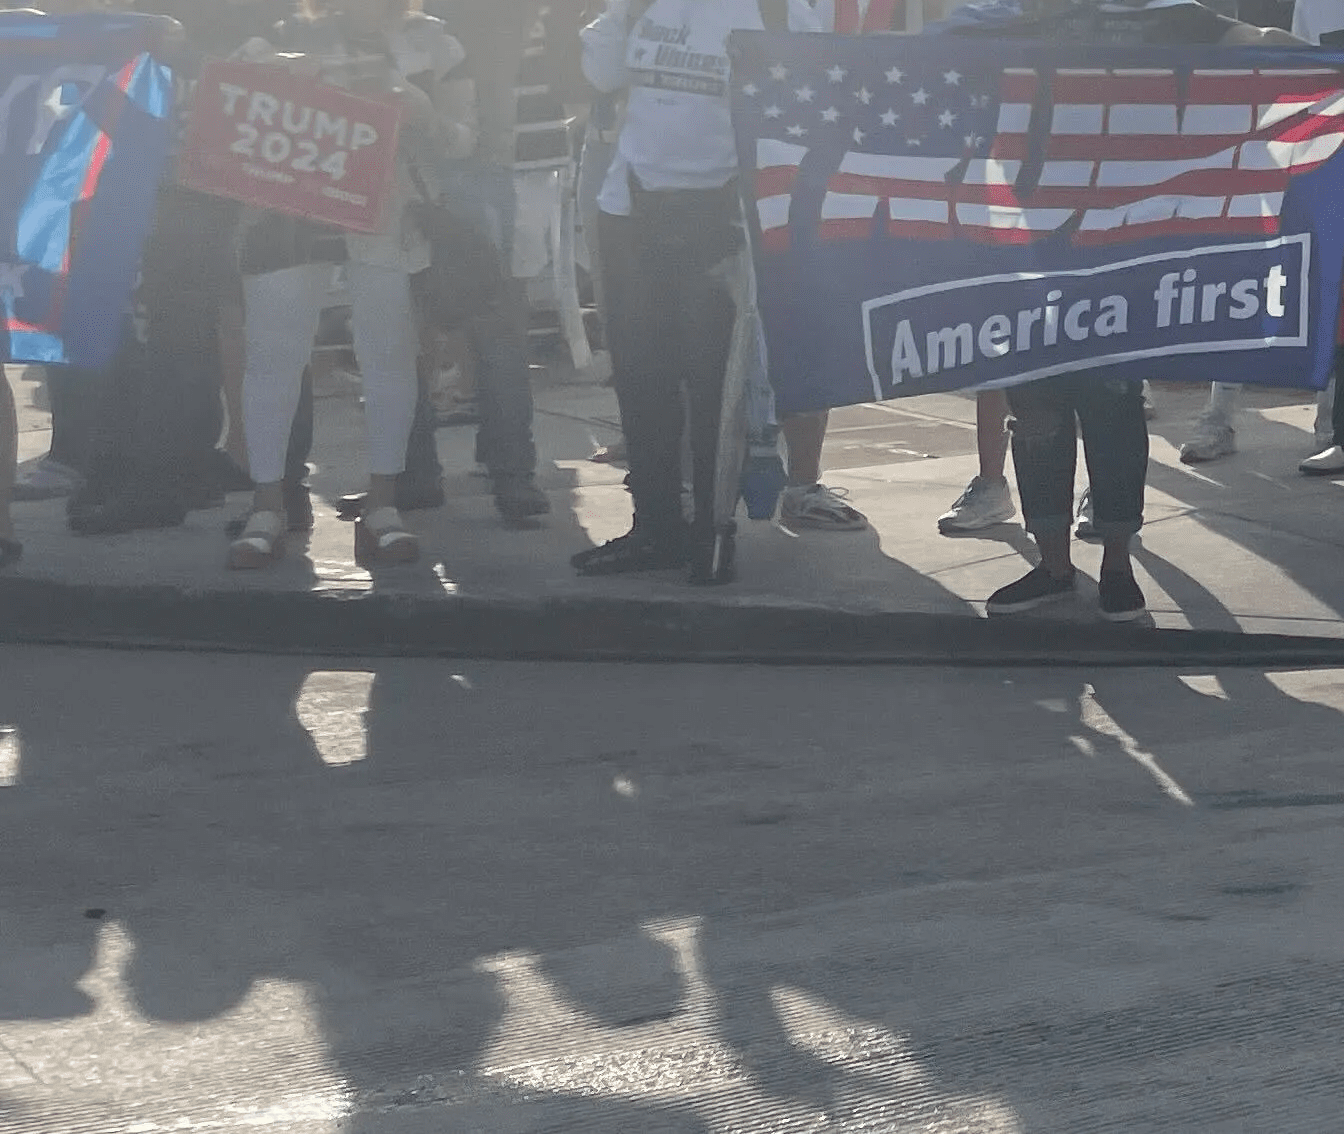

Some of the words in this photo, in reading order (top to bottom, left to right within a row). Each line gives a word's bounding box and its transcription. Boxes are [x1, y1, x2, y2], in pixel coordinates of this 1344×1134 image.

[219, 81, 379, 151] TRUMP
[229, 123, 348, 181] 2024
[892, 289, 1129, 385] America
[1154, 265, 1288, 328] first
